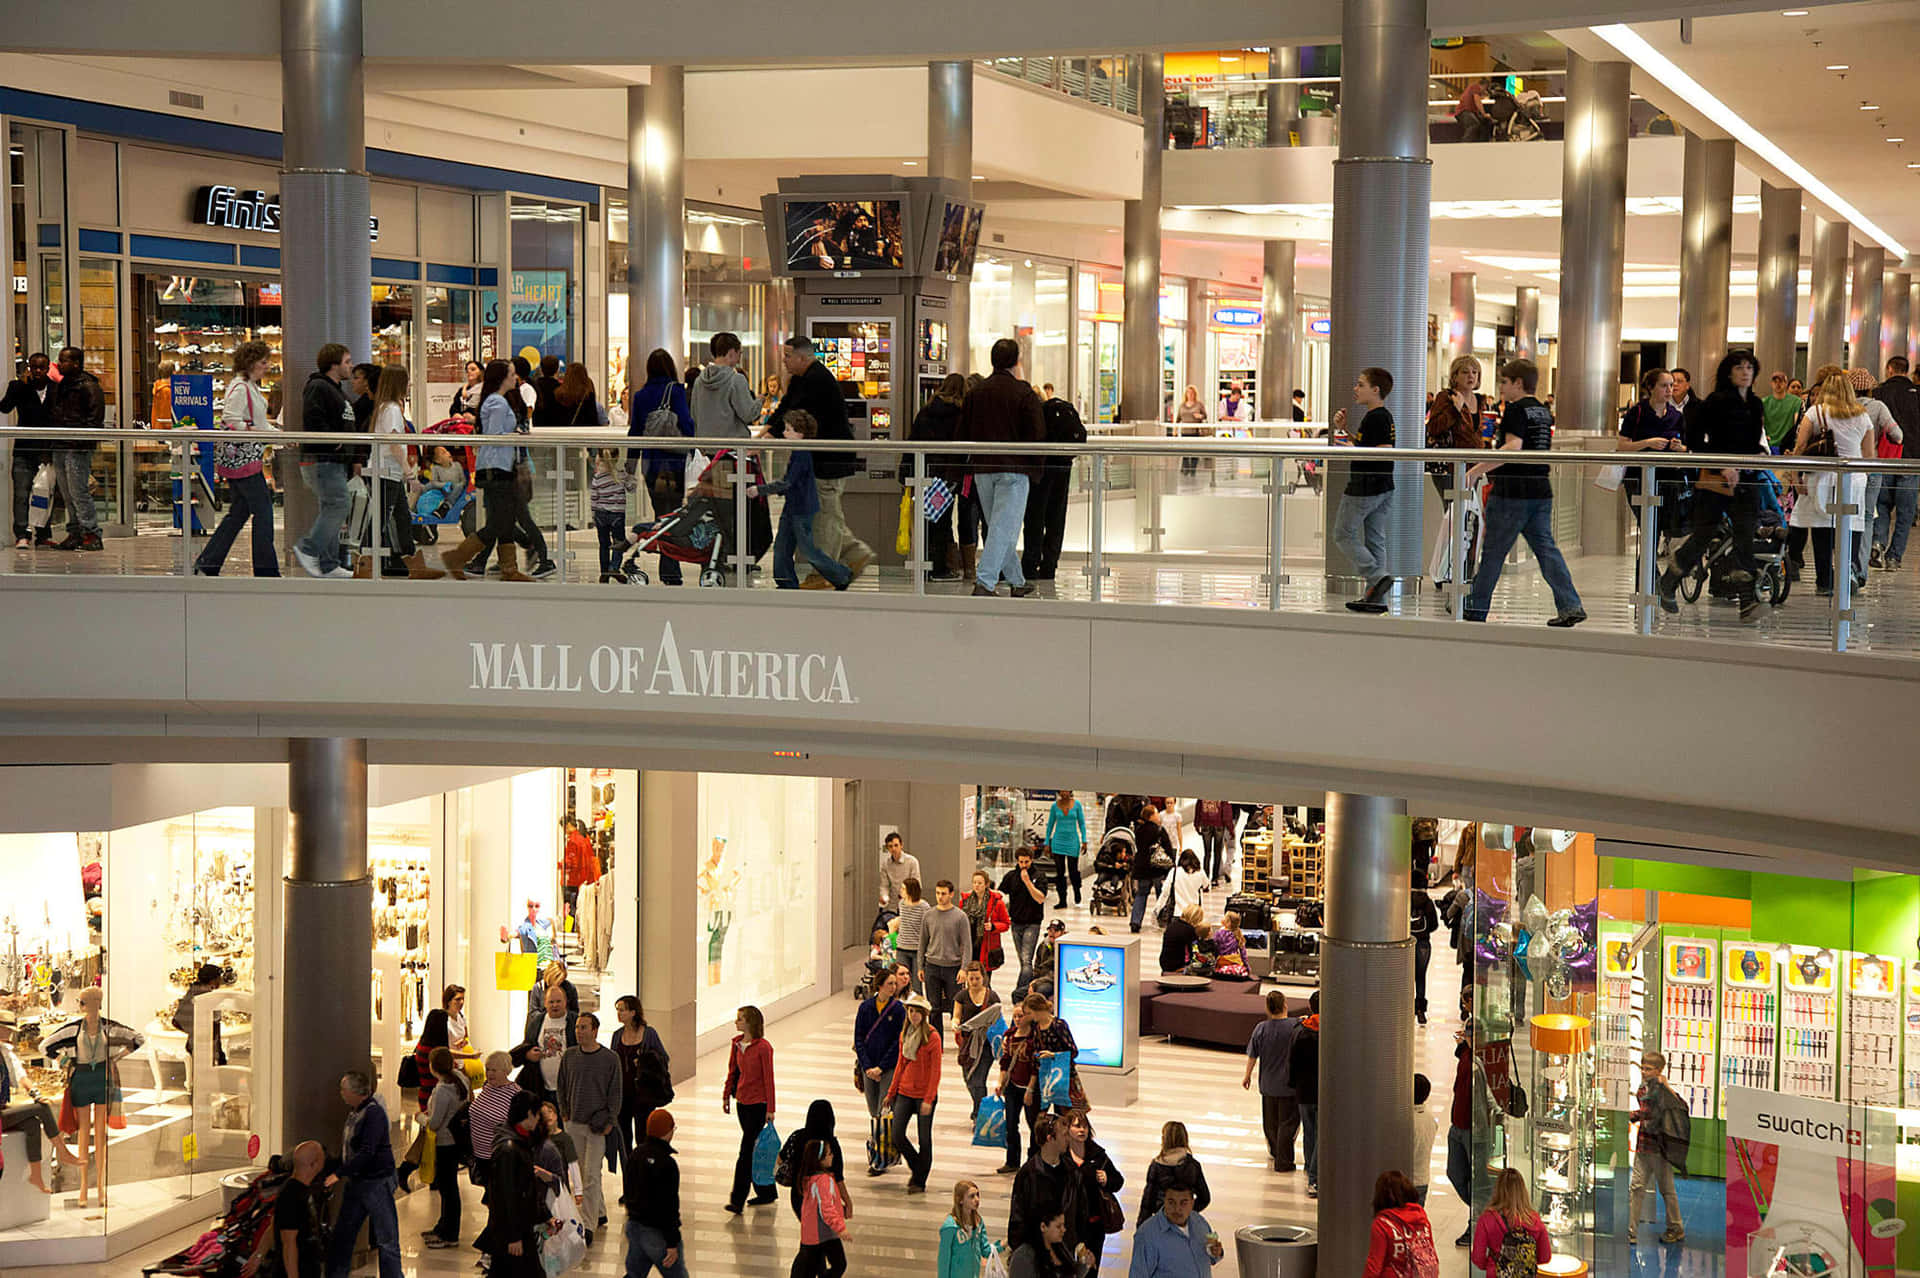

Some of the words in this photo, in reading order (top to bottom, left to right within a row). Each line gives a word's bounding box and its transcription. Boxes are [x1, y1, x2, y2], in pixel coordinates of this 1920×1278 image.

[206, 184, 281, 233] Finis
[525, 285, 562, 301] HEART
[174, 385, 191, 395] NEW
[174, 396, 209, 407] ARRIVALS
[469, 642, 582, 692] MALL
[589, 645, 645, 694] OF
[644, 620, 855, 704] AMERICA
[1757, 1113, 1845, 1143] swatch
